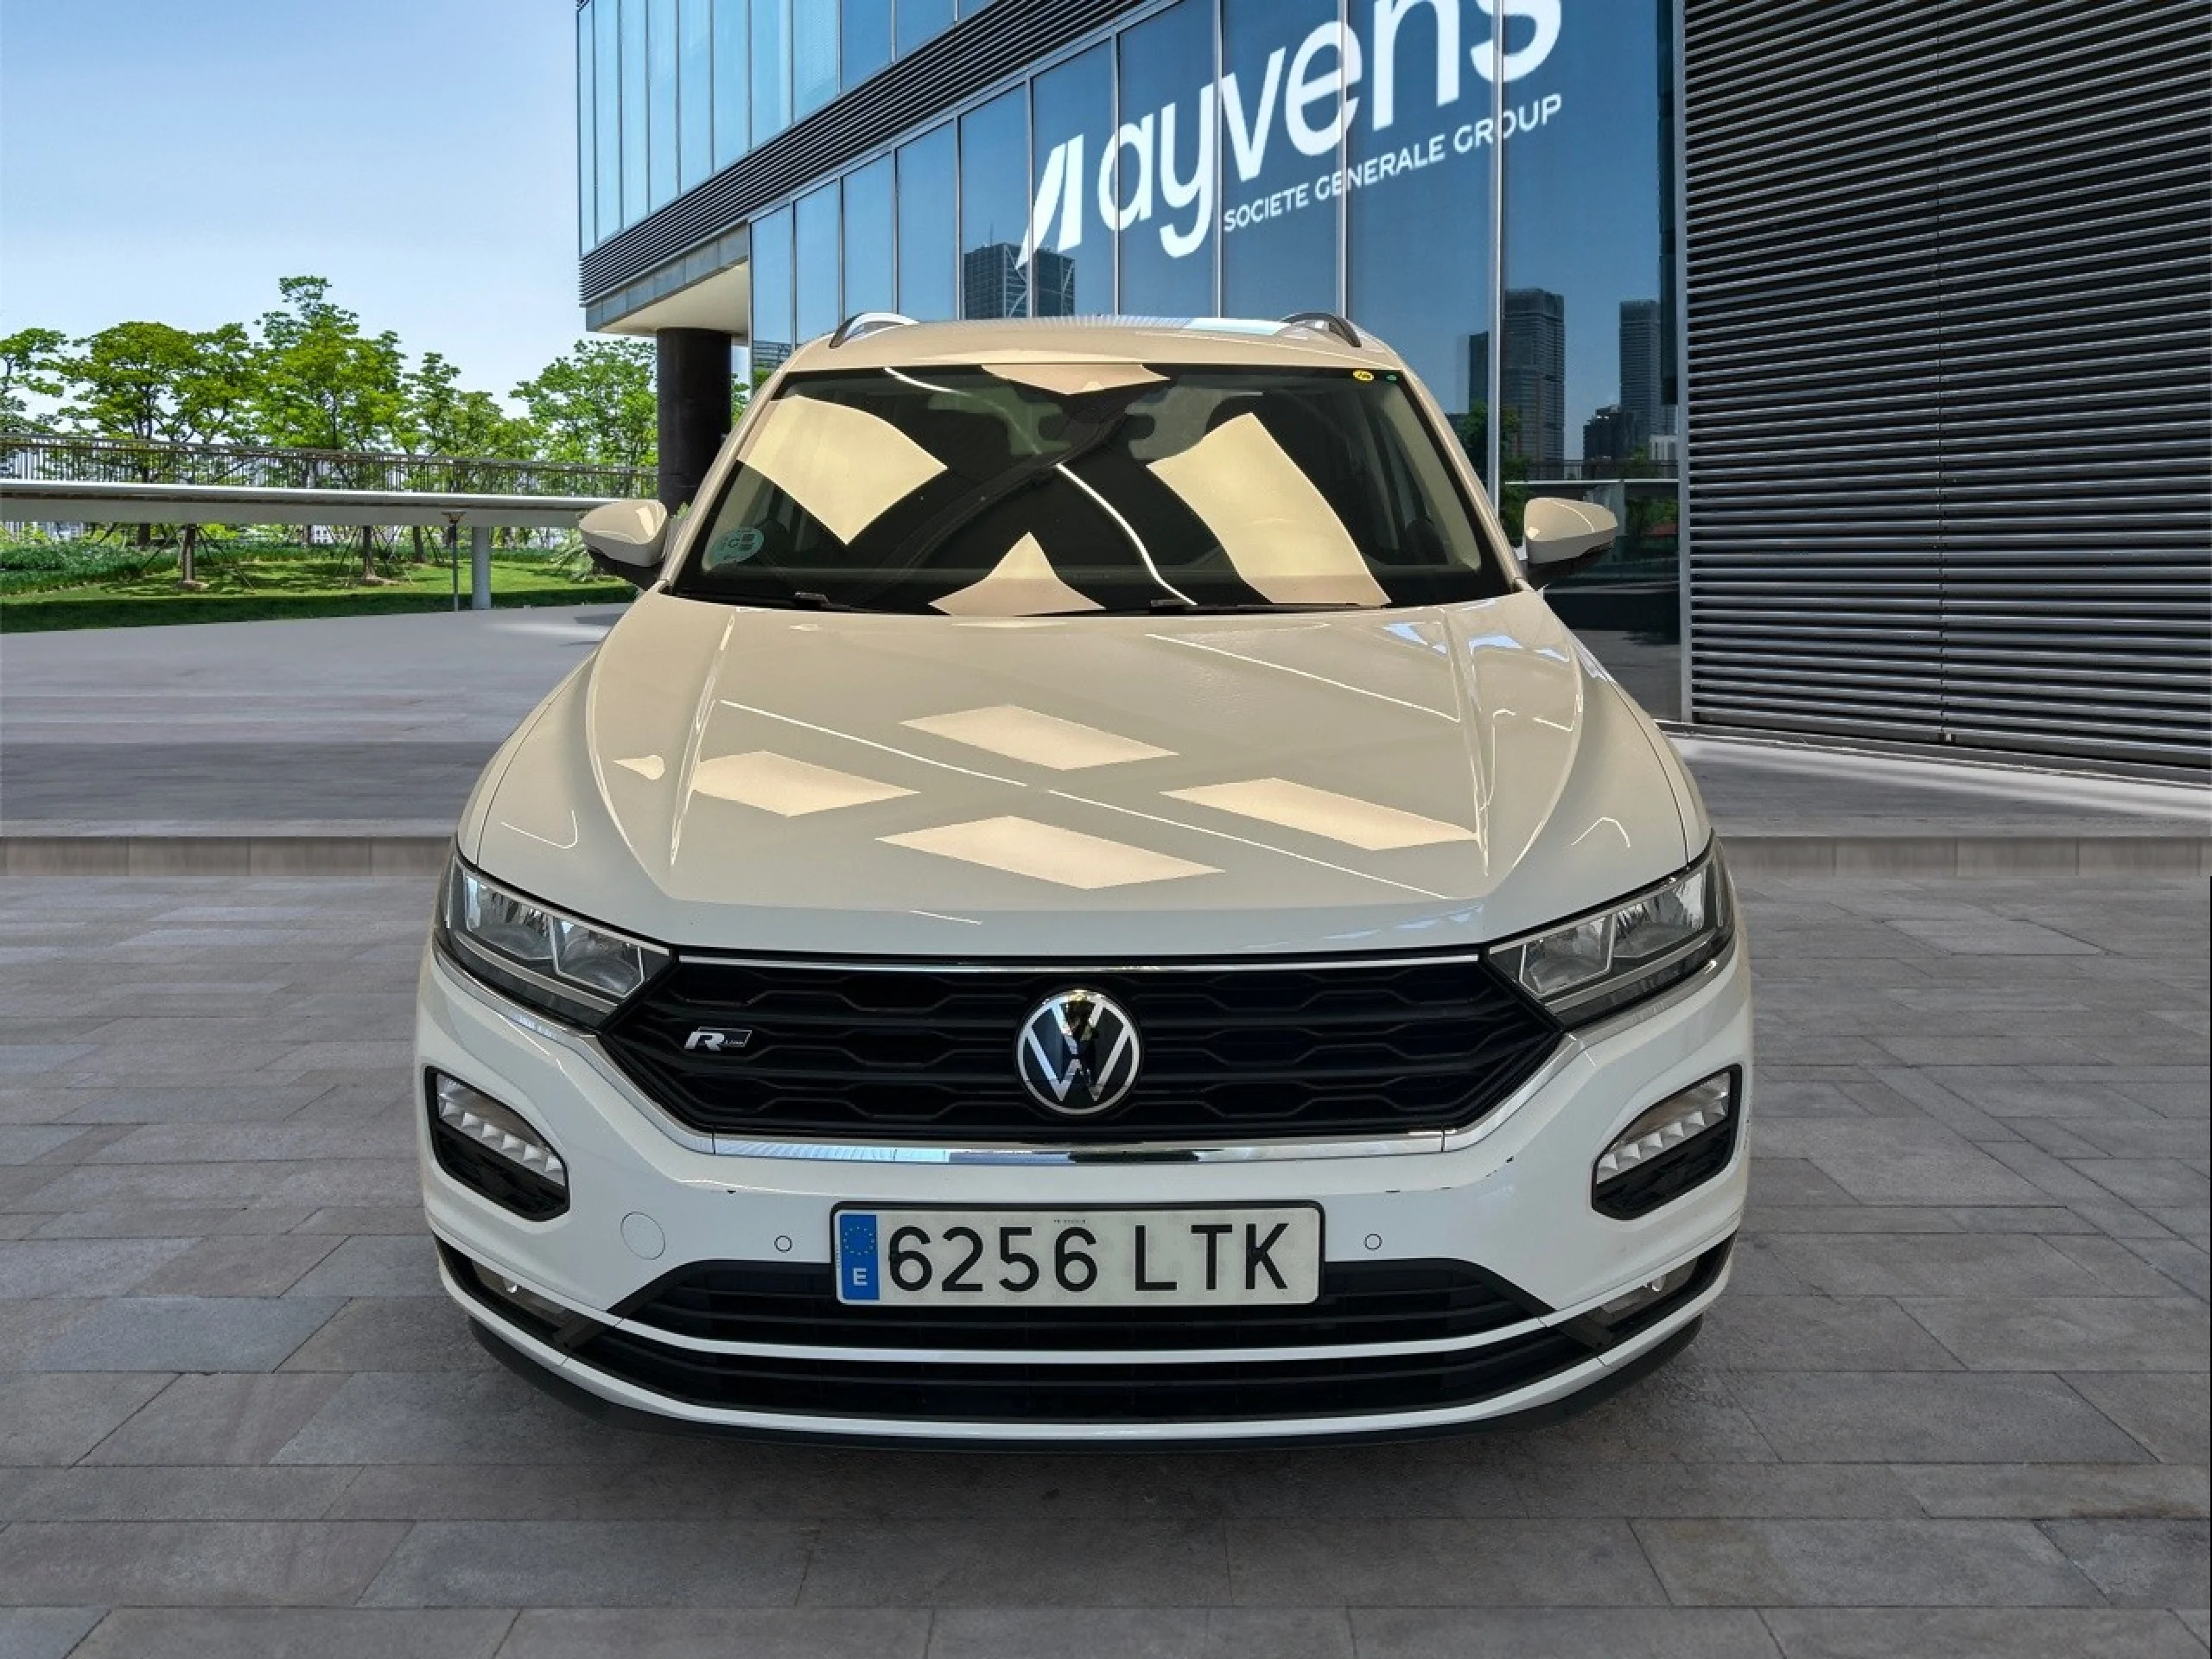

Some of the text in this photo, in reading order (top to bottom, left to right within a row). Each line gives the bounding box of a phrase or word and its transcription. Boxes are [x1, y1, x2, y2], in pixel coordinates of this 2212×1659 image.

[1224, 92, 1562, 232] SOCIETE GENERALE GROUP
[853, 1268, 868, 1286] E
[888, 1224, 1289, 1292] 6256 LTK
